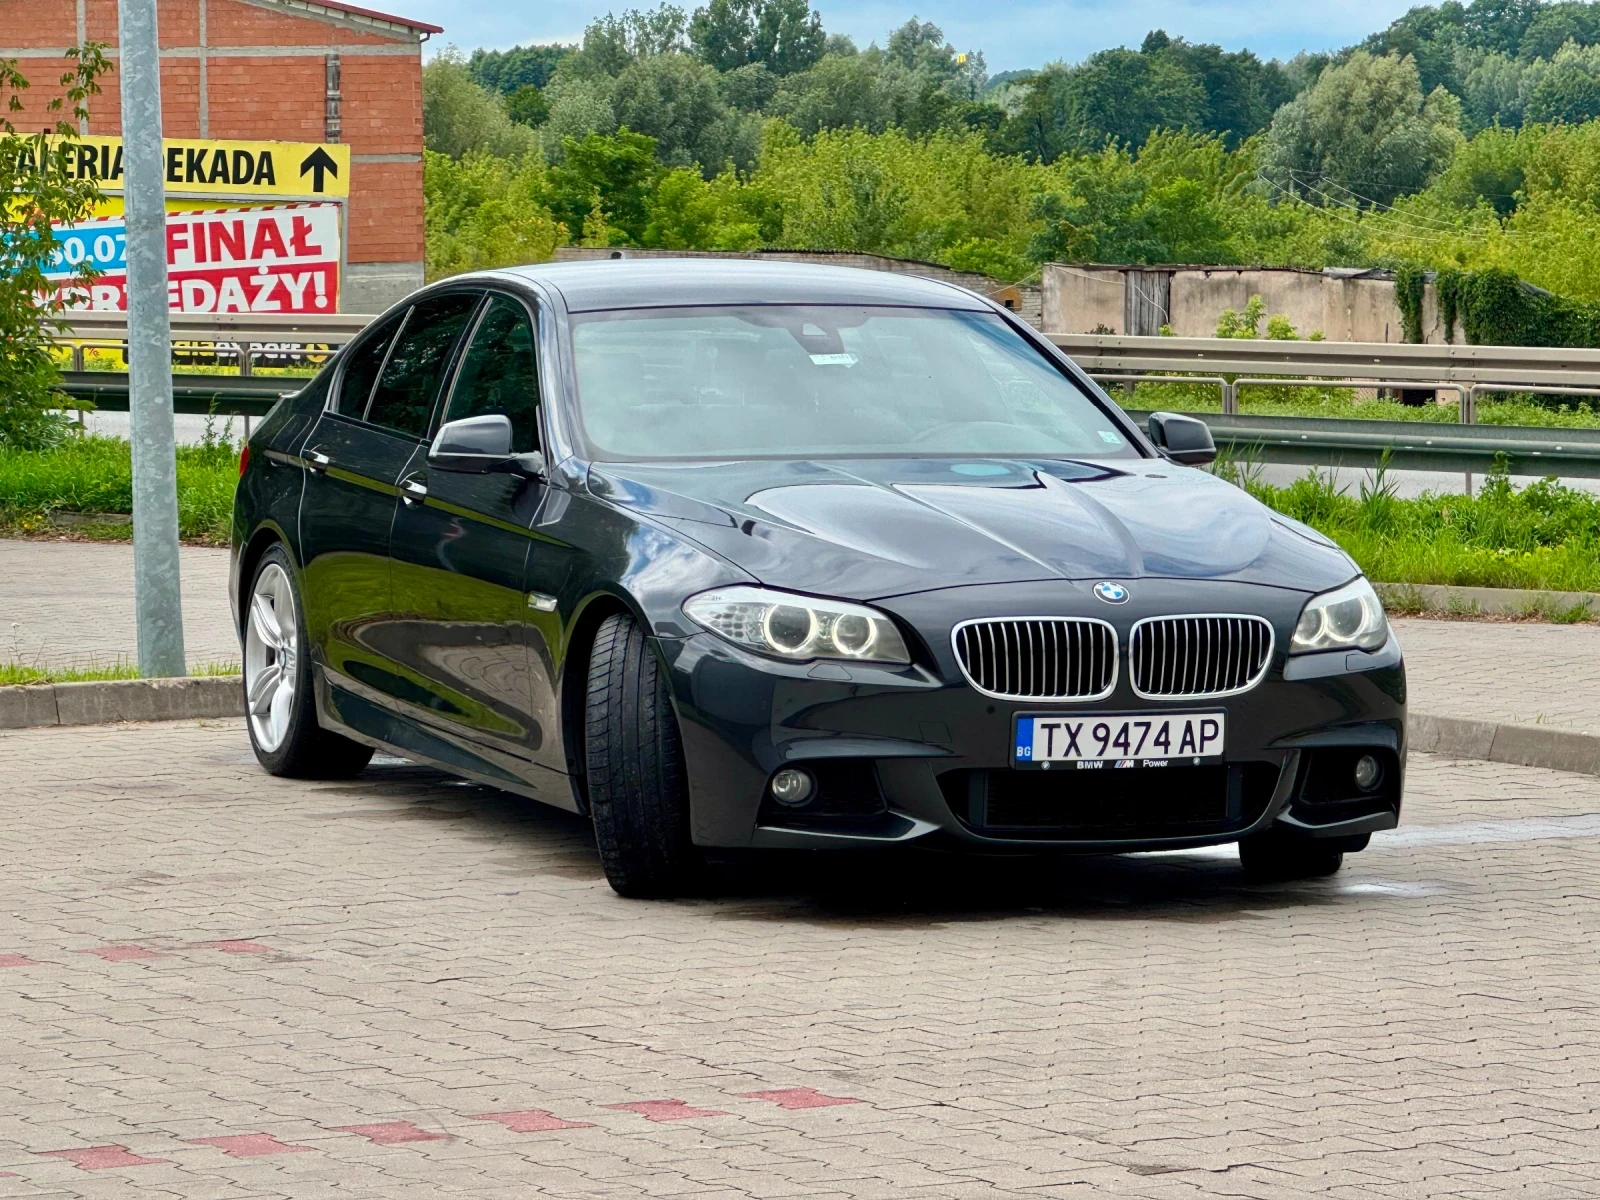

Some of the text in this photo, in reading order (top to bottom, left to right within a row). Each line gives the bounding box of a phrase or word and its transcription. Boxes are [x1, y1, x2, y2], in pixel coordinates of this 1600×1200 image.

[162, 147, 276, 186] EKADA
[166, 215, 322, 264] FINAŁ
[1016, 747, 1032, 757] BG
[1040, 718, 1219, 757] TX 9474 AP
[1076, 761, 1103, 770] BMW
[1142, 759, 1169, 768] Power
